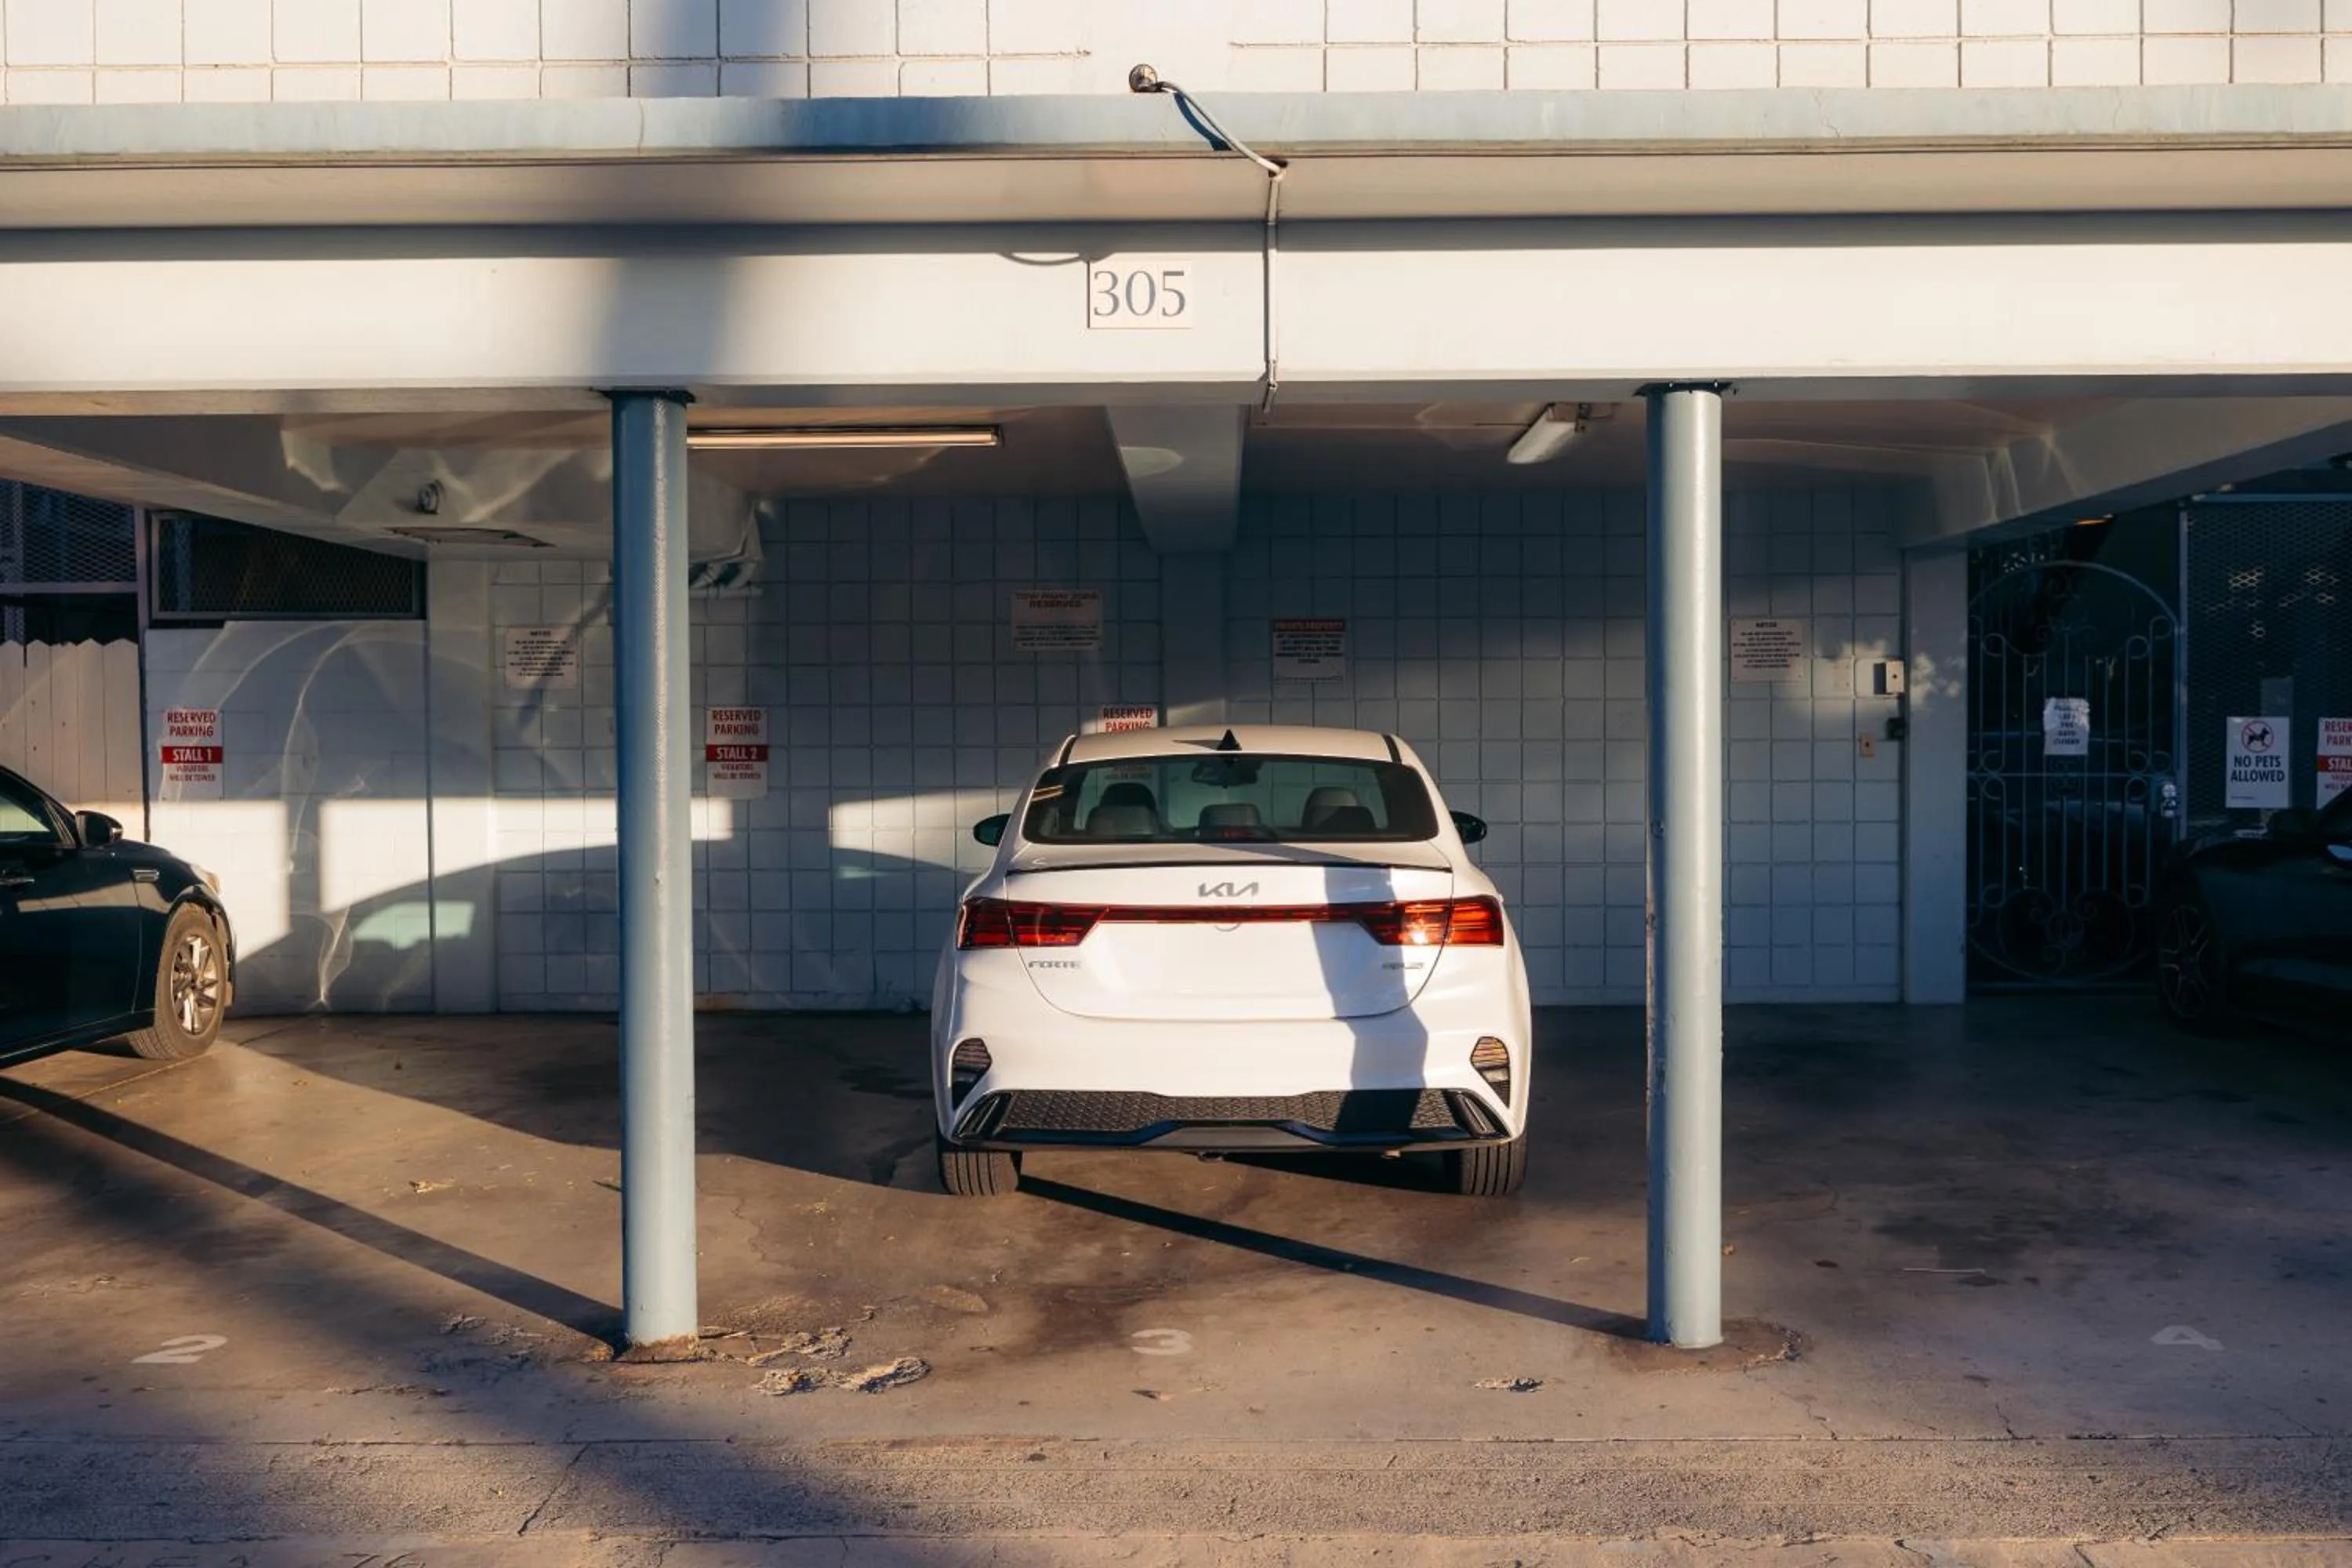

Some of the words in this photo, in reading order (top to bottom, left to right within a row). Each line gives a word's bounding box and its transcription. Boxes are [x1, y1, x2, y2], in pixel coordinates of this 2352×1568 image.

[1094, 270, 1186, 317] 305
[167, 711, 216, 724] RESERVED
[712, 710, 761, 721] RESERVED
[1103, 708, 1153, 719] RESERVED
[169, 725, 214, 737] PARKING
[714, 724, 759, 735] PARKING
[1105, 721, 1151, 733] PARKING
[172, 748, 204, 762] STALL
[207, 749, 212, 760] 1
[717, 746, 748, 760] STALL
[751, 747, 757, 759] 2
[2234, 755, 2252, 768] NO
[2256, 755, 2281, 768] PETS
[2231, 769, 2285, 782] ALLOWED
[1198, 881, 1259, 898] KIA
[1131, 1328, 1192, 1356] 3
[2150, 1325, 2226, 1351] 4
[129, 1334, 228, 1363] 2
